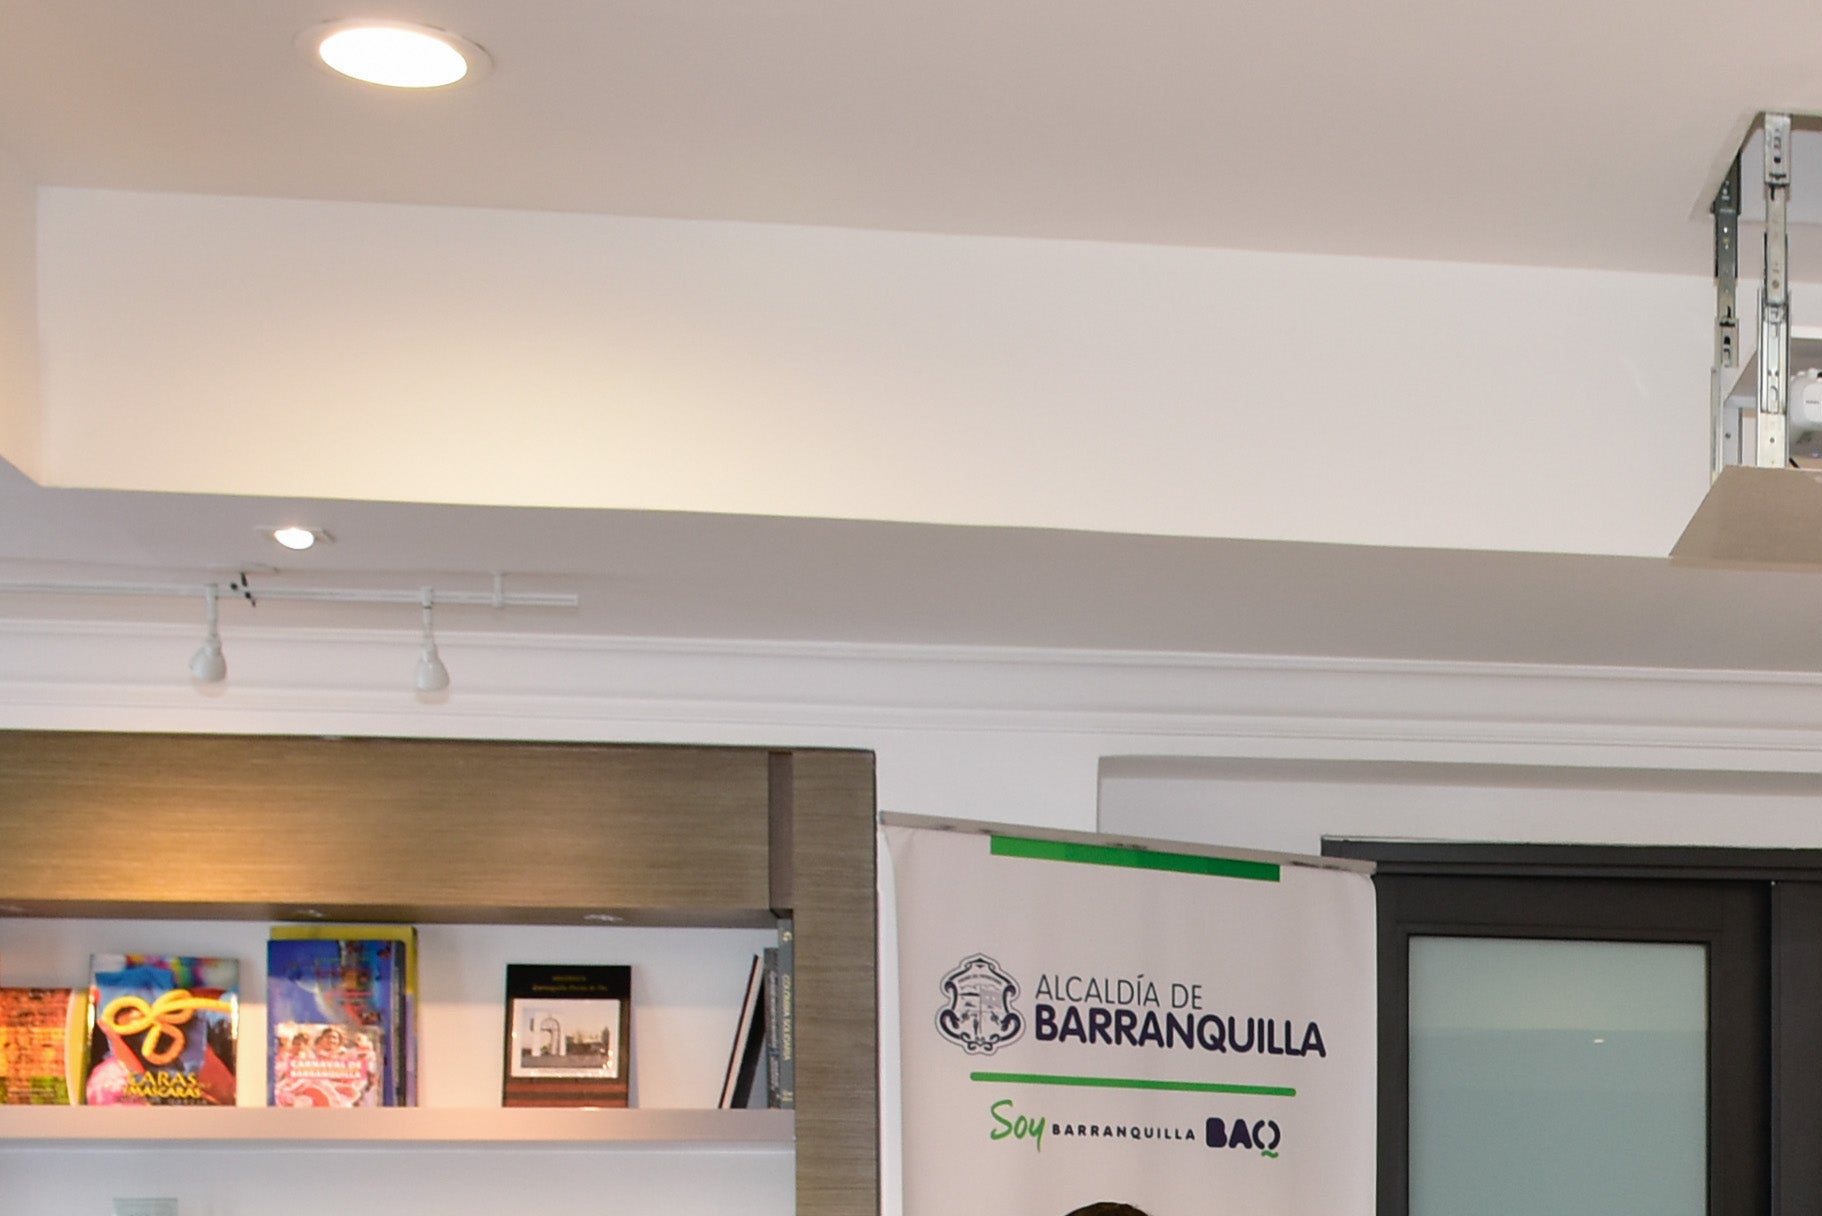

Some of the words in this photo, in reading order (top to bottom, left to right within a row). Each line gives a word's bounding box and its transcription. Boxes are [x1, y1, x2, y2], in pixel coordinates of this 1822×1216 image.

[1035, 973, 1160, 1008] ALCALDÍA
[1171, 983, 1203, 1010] DE
[1035, 1003, 1326, 1058] BARRANQUILLA
[128, 1070, 198, 1086] CARAS
[990, 1099, 1046, 1154] Soy
[1052, 1123, 1196, 1141] BARRANQUILLA
[1206, 1117, 1281, 1158] BAQ
